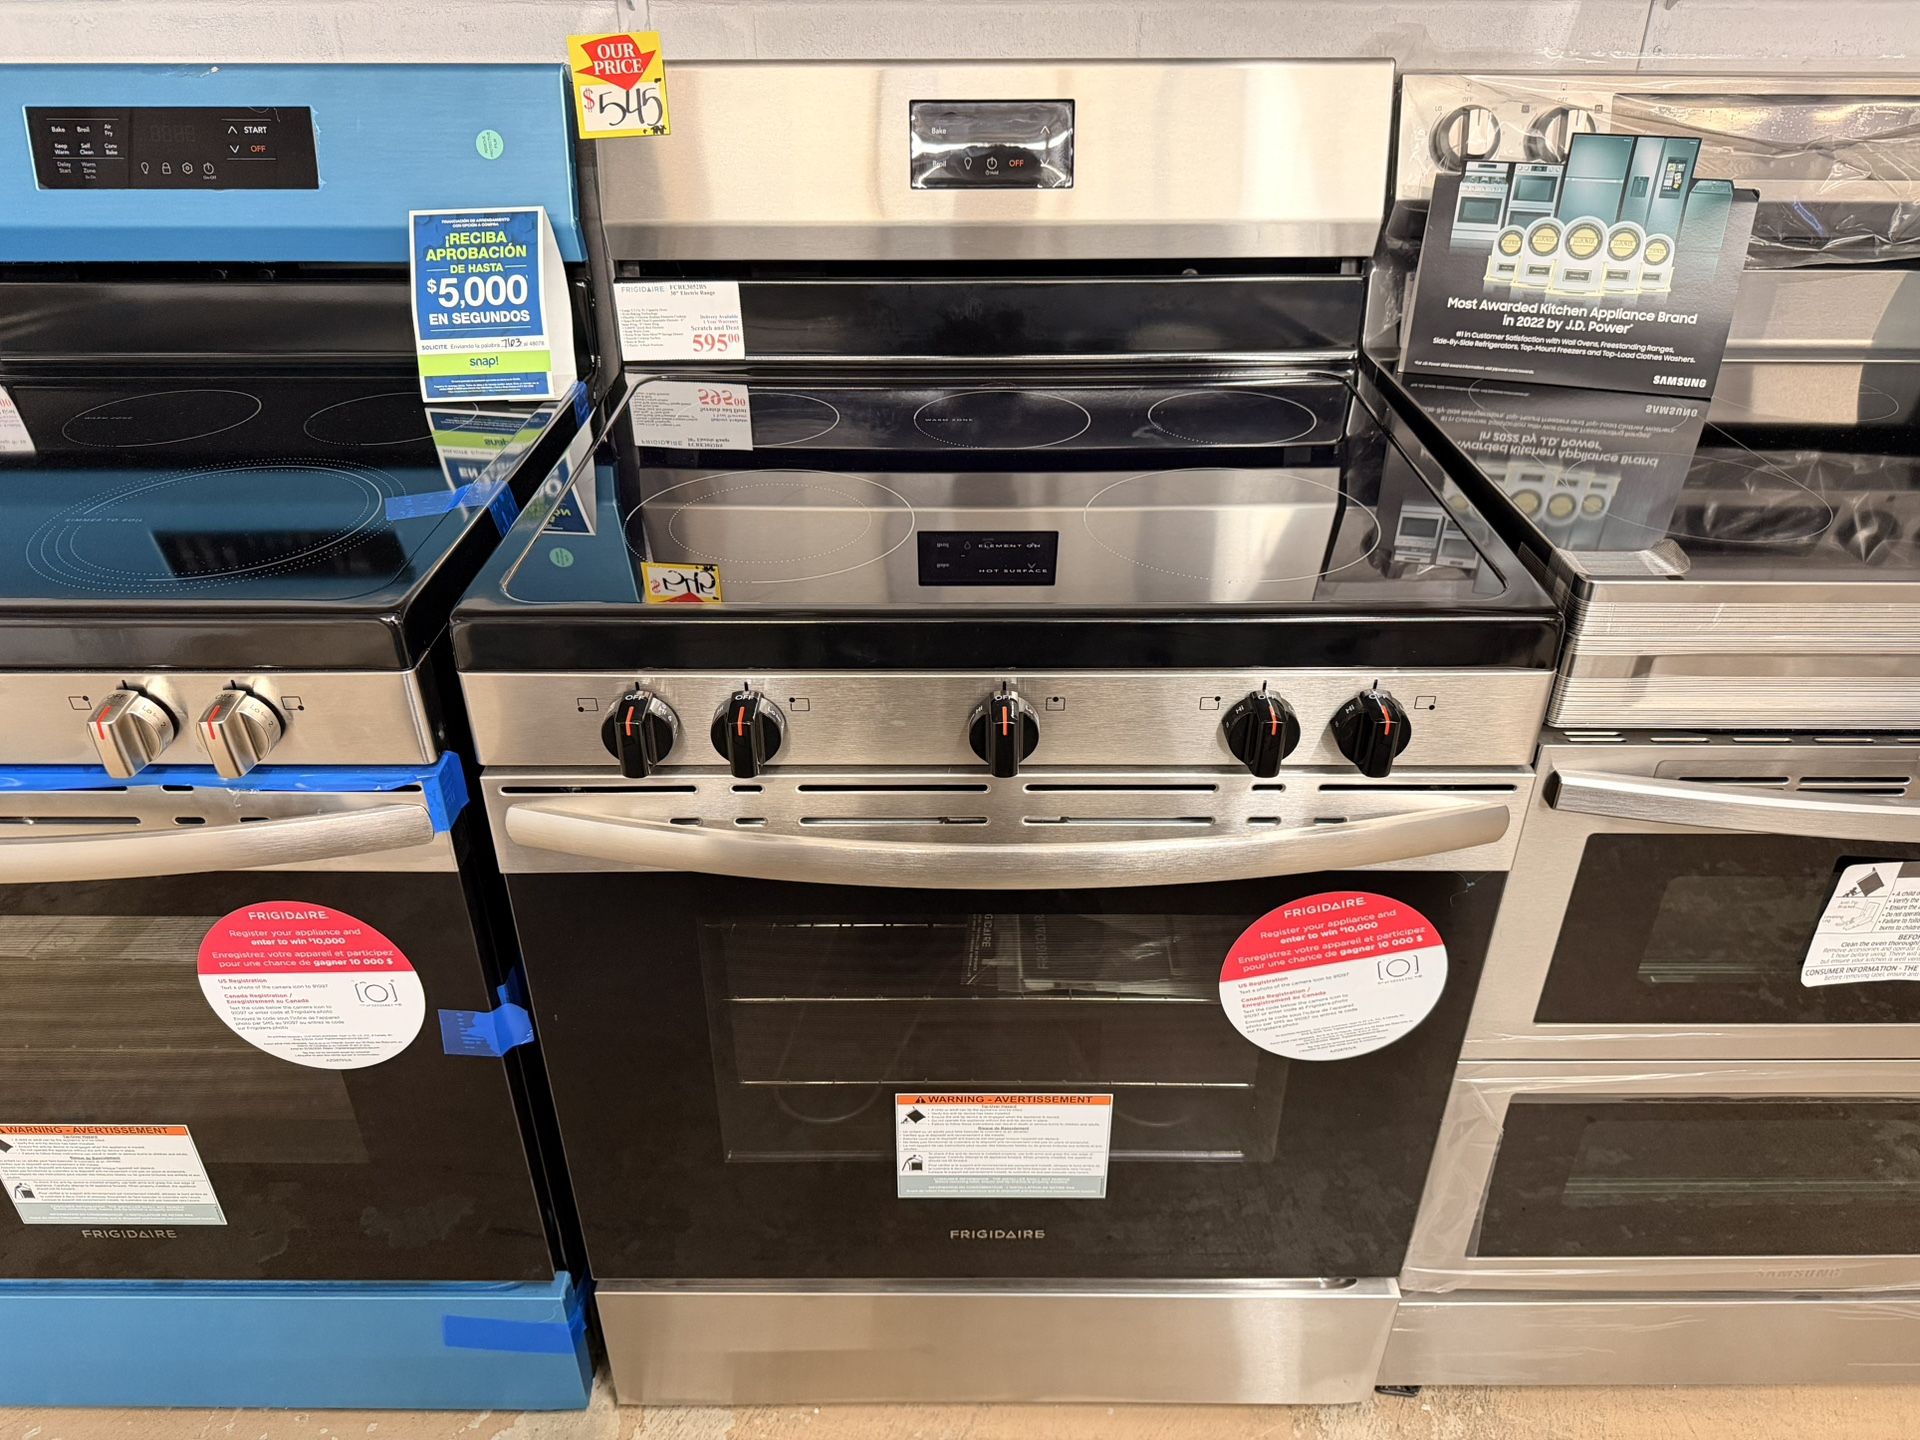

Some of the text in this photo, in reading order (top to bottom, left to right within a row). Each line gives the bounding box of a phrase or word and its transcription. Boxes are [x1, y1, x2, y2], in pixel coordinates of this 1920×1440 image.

[597, 43, 635, 59] OUR
[593, 58, 644, 76] PRICE
[243, 126, 268, 134] START
[931, 127, 947, 135] Bake
[250, 145, 266, 153] OFF
[445, 231, 507, 247] ¡RECIBA
[426, 243, 527, 261] APROBACIÓN
[450, 263, 503, 273] DE HASTA
[1447, 297, 1698, 324] Most Awarded Kitchen Appliance Brand
[429, 310, 530, 325] EN SEGUNDOS
[1502, 314, 1514, 326] in
[1516, 316, 1544, 328] 2022
[1546, 318, 1564, 332] by
[1565, 319, 1585, 331] J.D.
[693, 334, 728, 352] 595
[1471, 332, 1505, 340] Customer
[1505, 334, 1544, 343] Satisfaction
[1577, 340, 1600, 348] Ovens,
[1600, 341, 1646, 352] Freestanding
[1647, 345, 1674, 354] Ranges,
[1474, 340, 1519, 351] Refrigerators,
[1520, 344, 1556, 353] Top-Mount
[1557, 347, 1586, 355] Freezers
[1602, 350, 1635, 358] Top-Load
[1636, 352, 1662, 361] Clothes
[1663, 355, 1696, 363] Washers.
[469, 356, 499, 368] snap!
[1653, 375, 1707, 388] SAMSUNG
[1235, 705, 1244, 714] HI
[1345, 704, 1355, 714] HI
[1283, 897, 1367, 919] FRIGIDAIRE
[248, 911, 329, 920] FRIGIDAIRE
[1260, 909, 1397, 939] Register your appliance and
[1280, 935, 1305, 944] enter
[1320, 929, 1338, 937] win
[1340, 921, 1378, 933] $10,000
[308, 937, 346, 945] $10,000
[1238, 927, 1426, 964] Enregistrez votre appareil et participez
[212, 951, 265, 959] Enregistrez
[346, 949, 394, 957] participez
[1243, 963, 1265, 973] pour
[1267, 960, 1285, 968] une
[1287, 953, 1322, 964] chance
[1340, 945, 1375, 956] gagner
[1391, 937, 1414, 946] 000
[219, 960, 241, 968] pour
[313, 959, 347, 967] gagner
[1805, 967, 1844, 976] CONSUMER
[1846, 965, 1897, 973] INFORMATION
[1249, 976, 1288, 987] Registration
[928, 1096, 1093, 1104] WARNING AVERTISSEMENT
[6, 1126, 168, 1134] WARNING AVERTISSEMENT
[81, 1229, 178, 1239] FRIGIDAIRE
[950, 1230, 1046, 1239] FRIGIDAIRE
